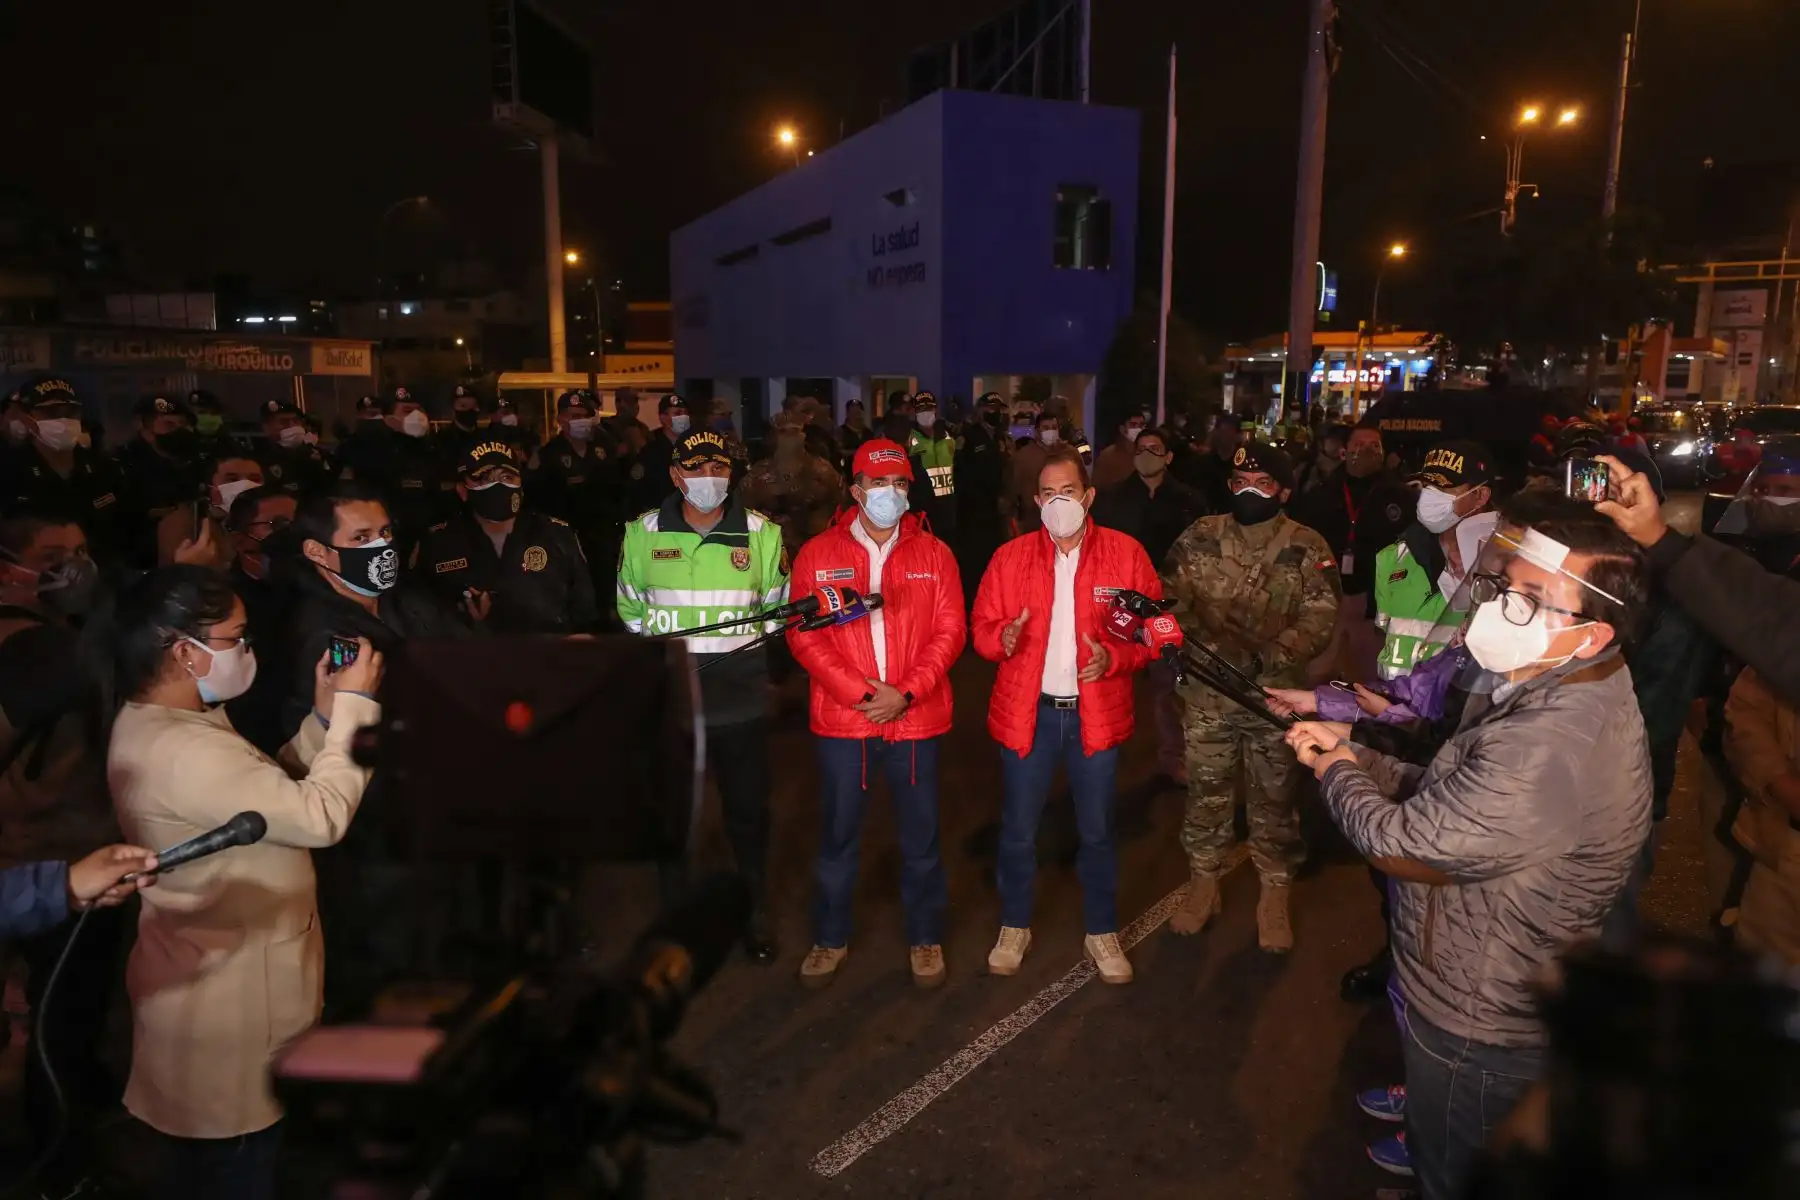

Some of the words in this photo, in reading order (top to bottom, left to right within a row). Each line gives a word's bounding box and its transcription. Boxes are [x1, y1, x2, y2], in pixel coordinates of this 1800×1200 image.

[872, 231, 886, 257] La
[887, 219, 920, 253] salud
[470, 441, 513, 462] POLICIA
[684, 431, 724, 451] POLICIA
